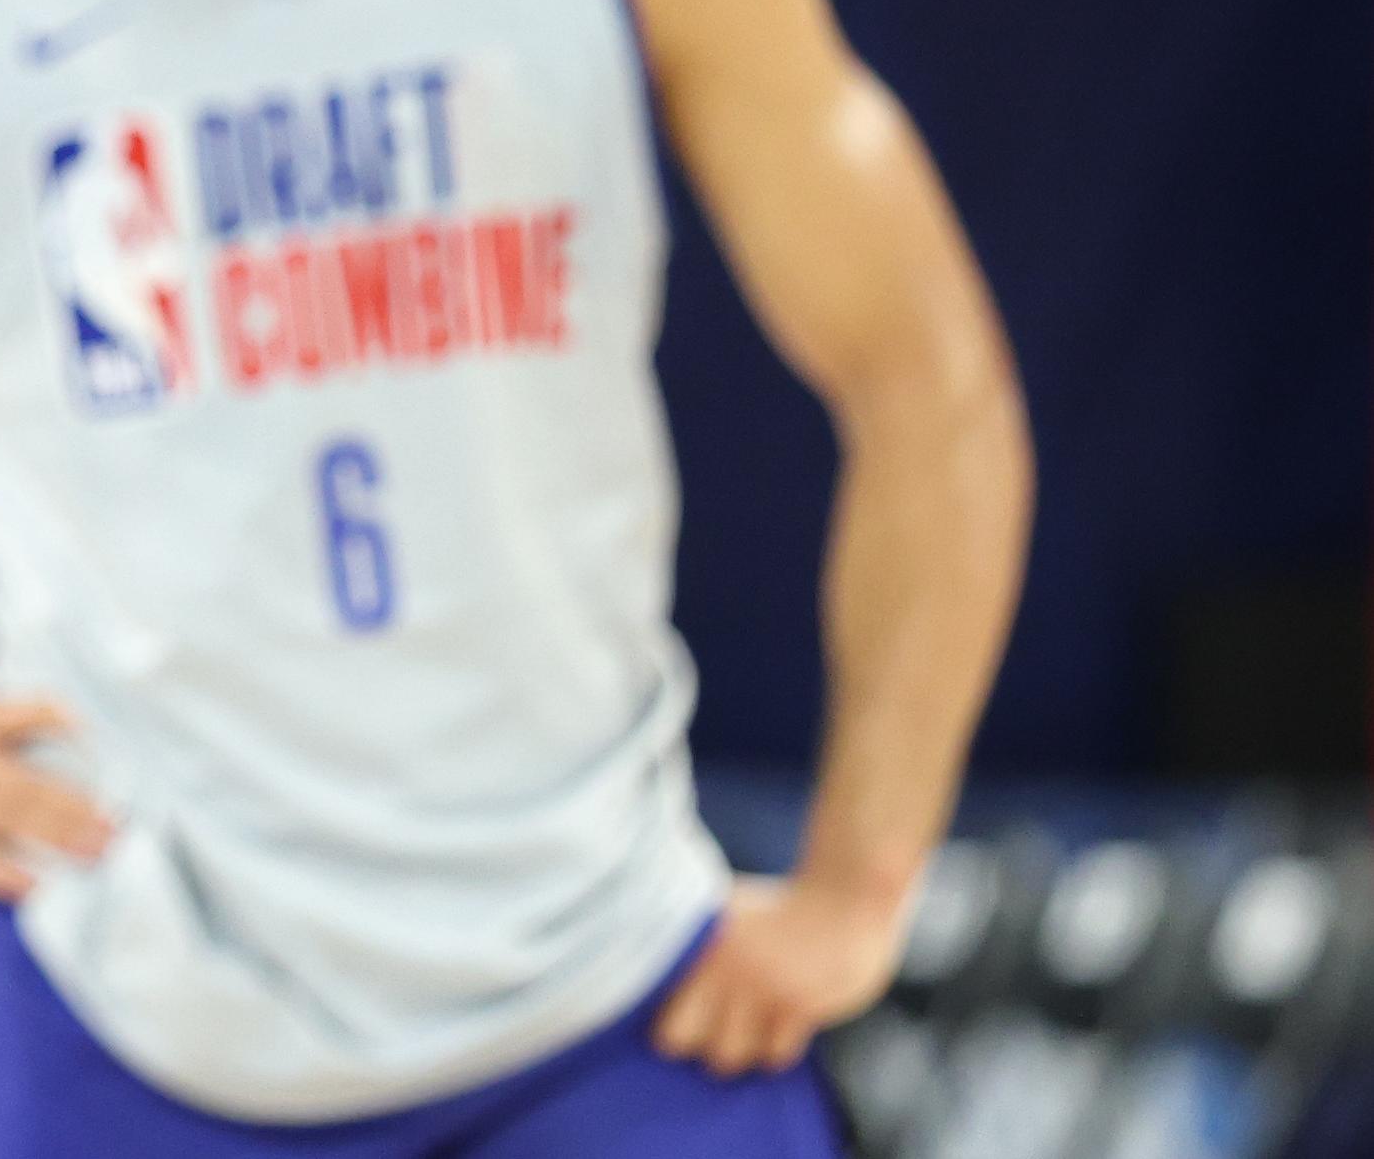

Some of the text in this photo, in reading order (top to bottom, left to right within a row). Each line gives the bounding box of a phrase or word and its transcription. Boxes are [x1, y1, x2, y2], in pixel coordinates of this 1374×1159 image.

[197, 69, 450, 238] DRAFT
[215, 209, 573, 385] COMBINE
[317, 440, 398, 630] 6
